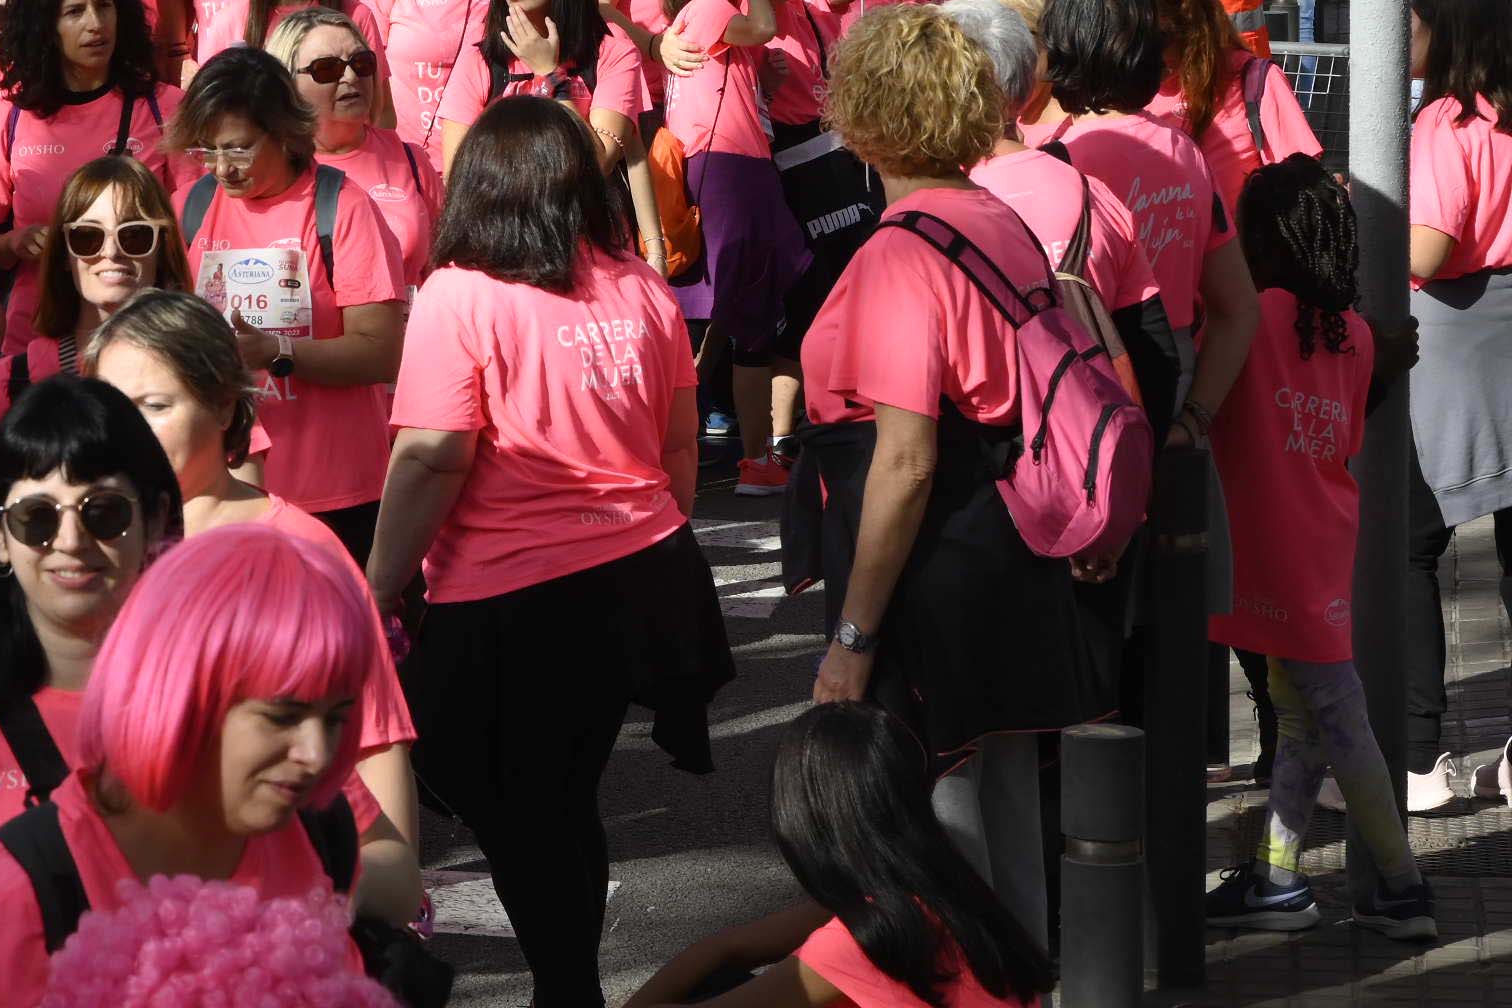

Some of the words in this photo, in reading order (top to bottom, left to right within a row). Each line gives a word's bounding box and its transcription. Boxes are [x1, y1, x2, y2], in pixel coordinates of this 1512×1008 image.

[19, 144, 65, 157] OYSHO
[806, 204, 861, 240] PUMA
[232, 267, 271, 280] ASTURIANA
[230, 294, 270, 310] 016
[557, 319, 651, 347] CARRERA
[580, 345, 605, 368] DE
[1275, 388, 1350, 424] CRRERA
[580, 509, 634, 526] OYSHO
